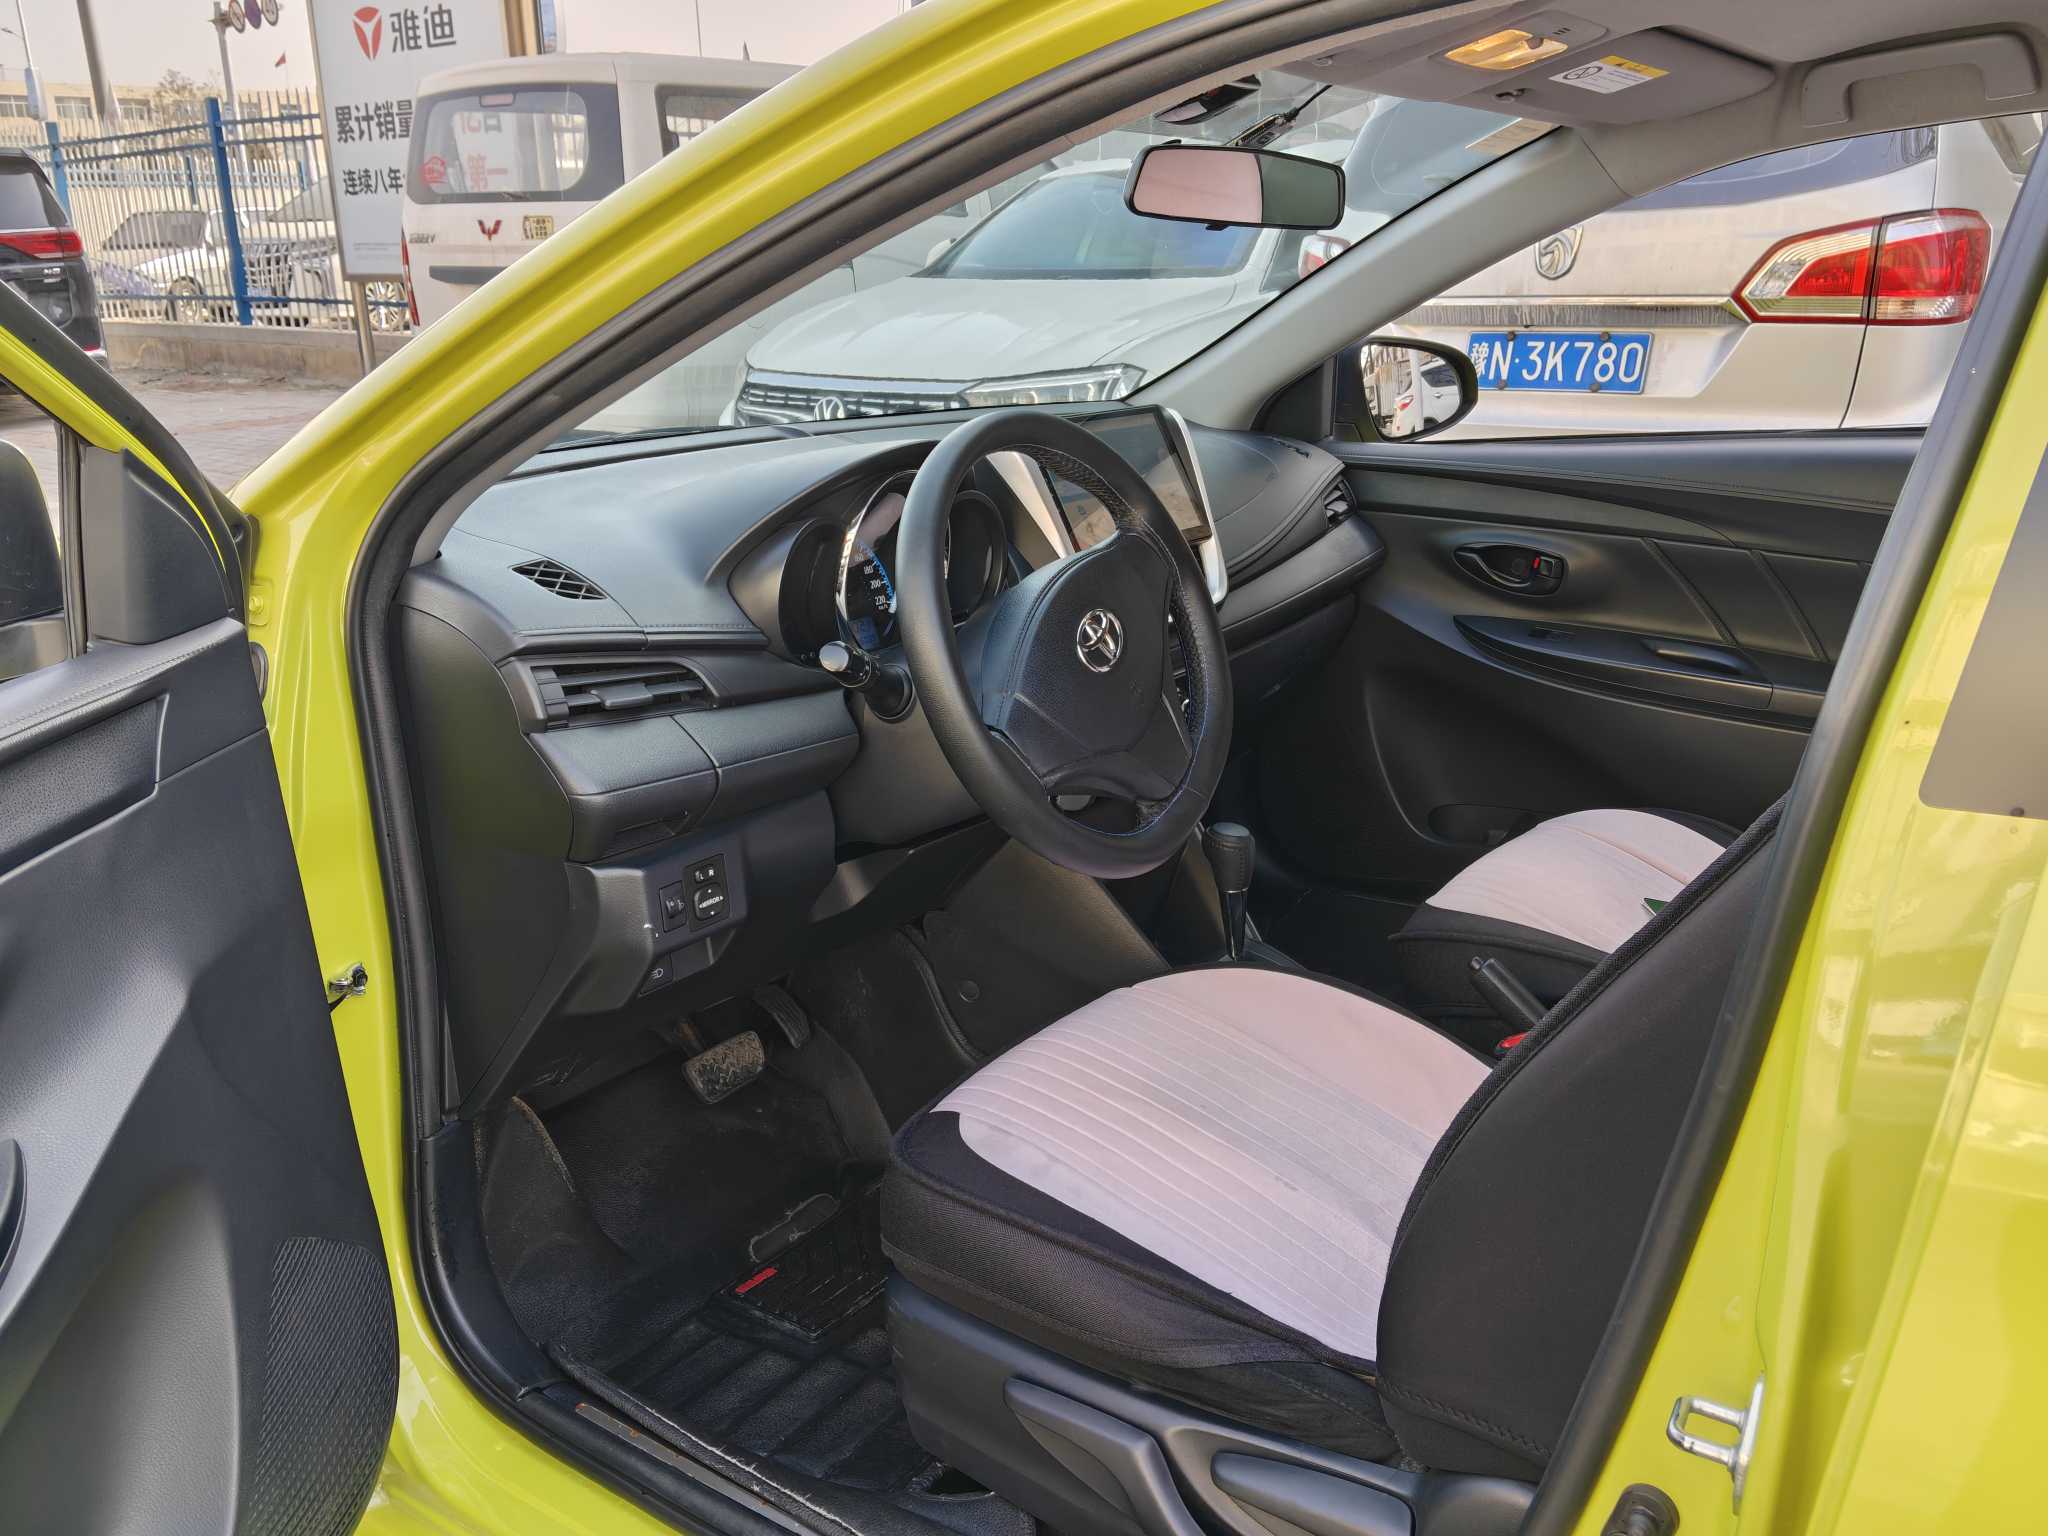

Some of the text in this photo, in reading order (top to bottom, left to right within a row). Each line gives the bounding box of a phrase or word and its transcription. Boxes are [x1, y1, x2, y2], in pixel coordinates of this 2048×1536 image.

[389, 3, 456, 53] 雅迪
[335, 99, 413, 143] 累计销量
[870, 579, 881, 589] 200
[875, 594, 886, 604] 220
